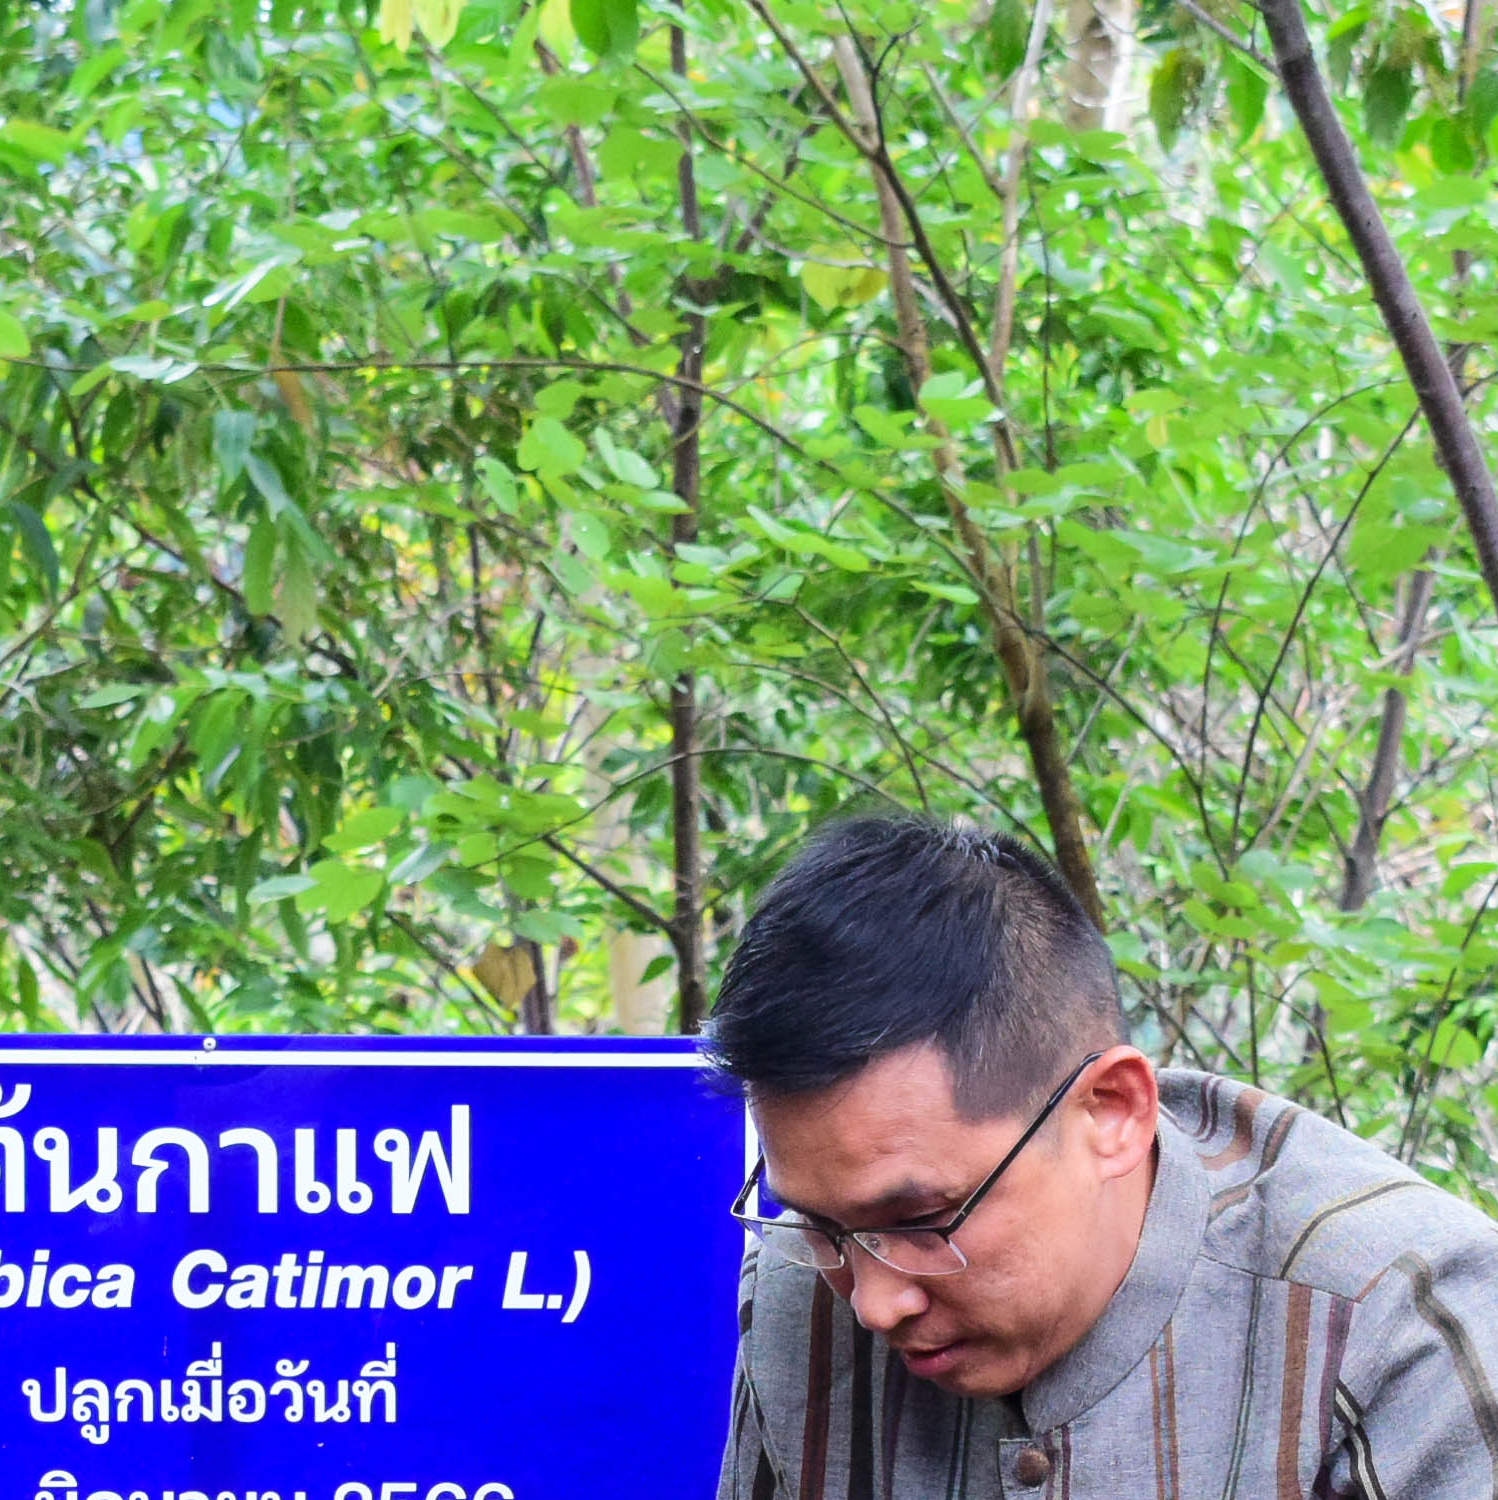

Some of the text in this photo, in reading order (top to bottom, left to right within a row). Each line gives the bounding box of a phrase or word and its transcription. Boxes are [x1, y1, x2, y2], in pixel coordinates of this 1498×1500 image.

[172, 1249, 474, 1310] Catimor
[502, 1250, 591, 1323] L.)
[21, 1341, 397, 1445] ปลูกเมื่อวันที่
